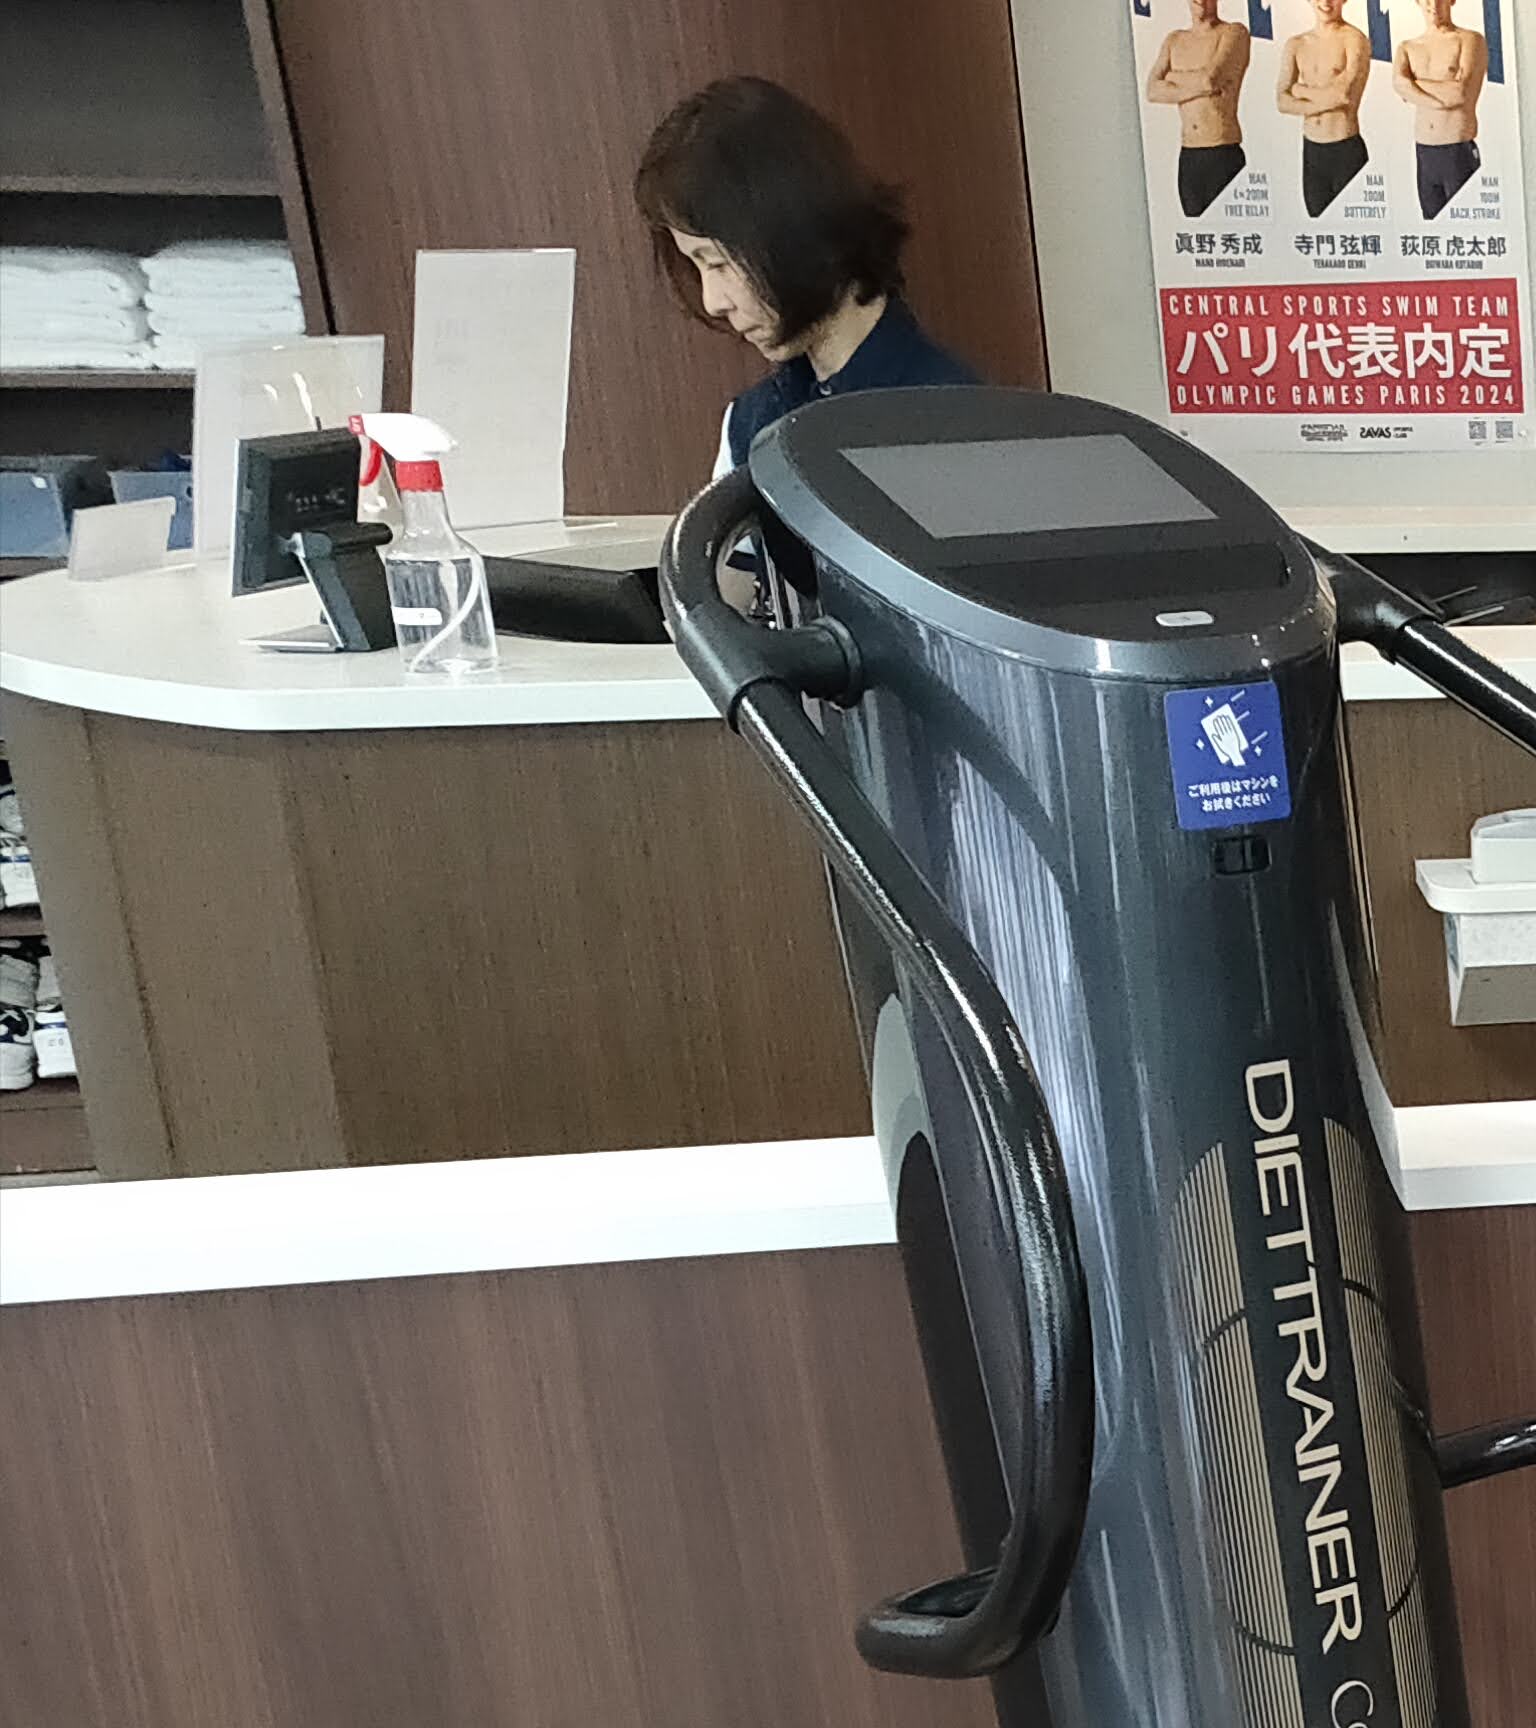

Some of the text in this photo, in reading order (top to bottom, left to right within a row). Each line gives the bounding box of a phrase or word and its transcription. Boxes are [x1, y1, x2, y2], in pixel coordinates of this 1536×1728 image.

[1169, 295, 1508, 317] CENTRAL SPORTS SWIM TEAM
[1176, 322, 1512, 380] パリ代表内定
[1176, 384, 1513, 405] OLYMPIC GAMES PARIS 2024
[1360, 426, 1392, 439] SAVAS
[1188, 775, 1280, 799] ご利用後はマシンを
[1202, 792, 1271, 812] お拭きください
